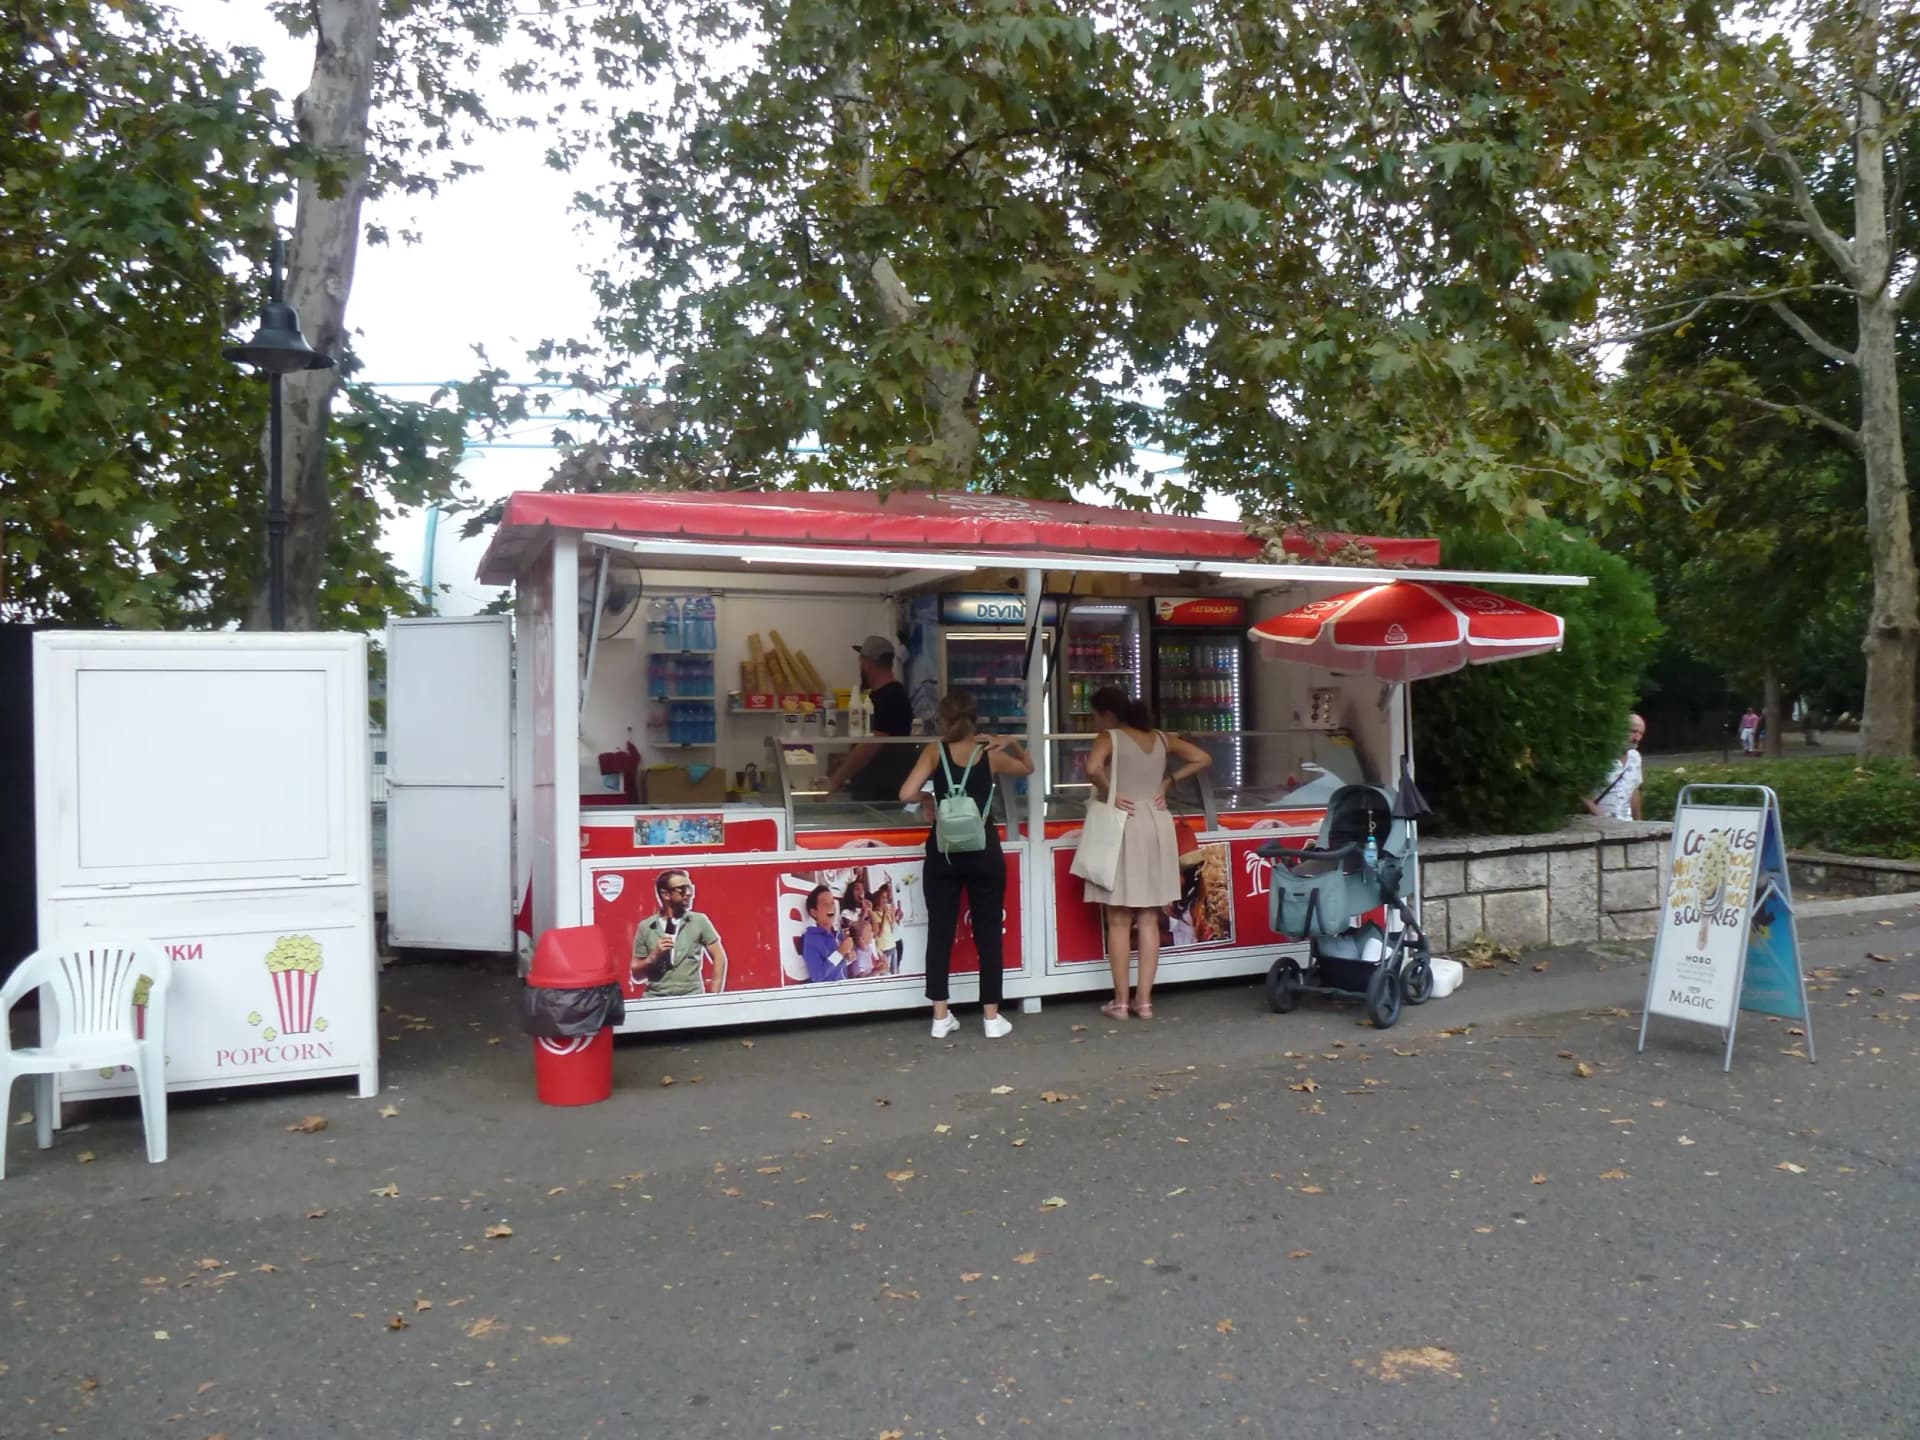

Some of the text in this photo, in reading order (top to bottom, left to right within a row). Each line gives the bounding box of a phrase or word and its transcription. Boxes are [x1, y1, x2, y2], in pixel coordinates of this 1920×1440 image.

[977, 603, 1025, 619] DEVIN
[1669, 989, 1716, 1010] MAGIC
[215, 1041, 334, 1068] POPCORN
